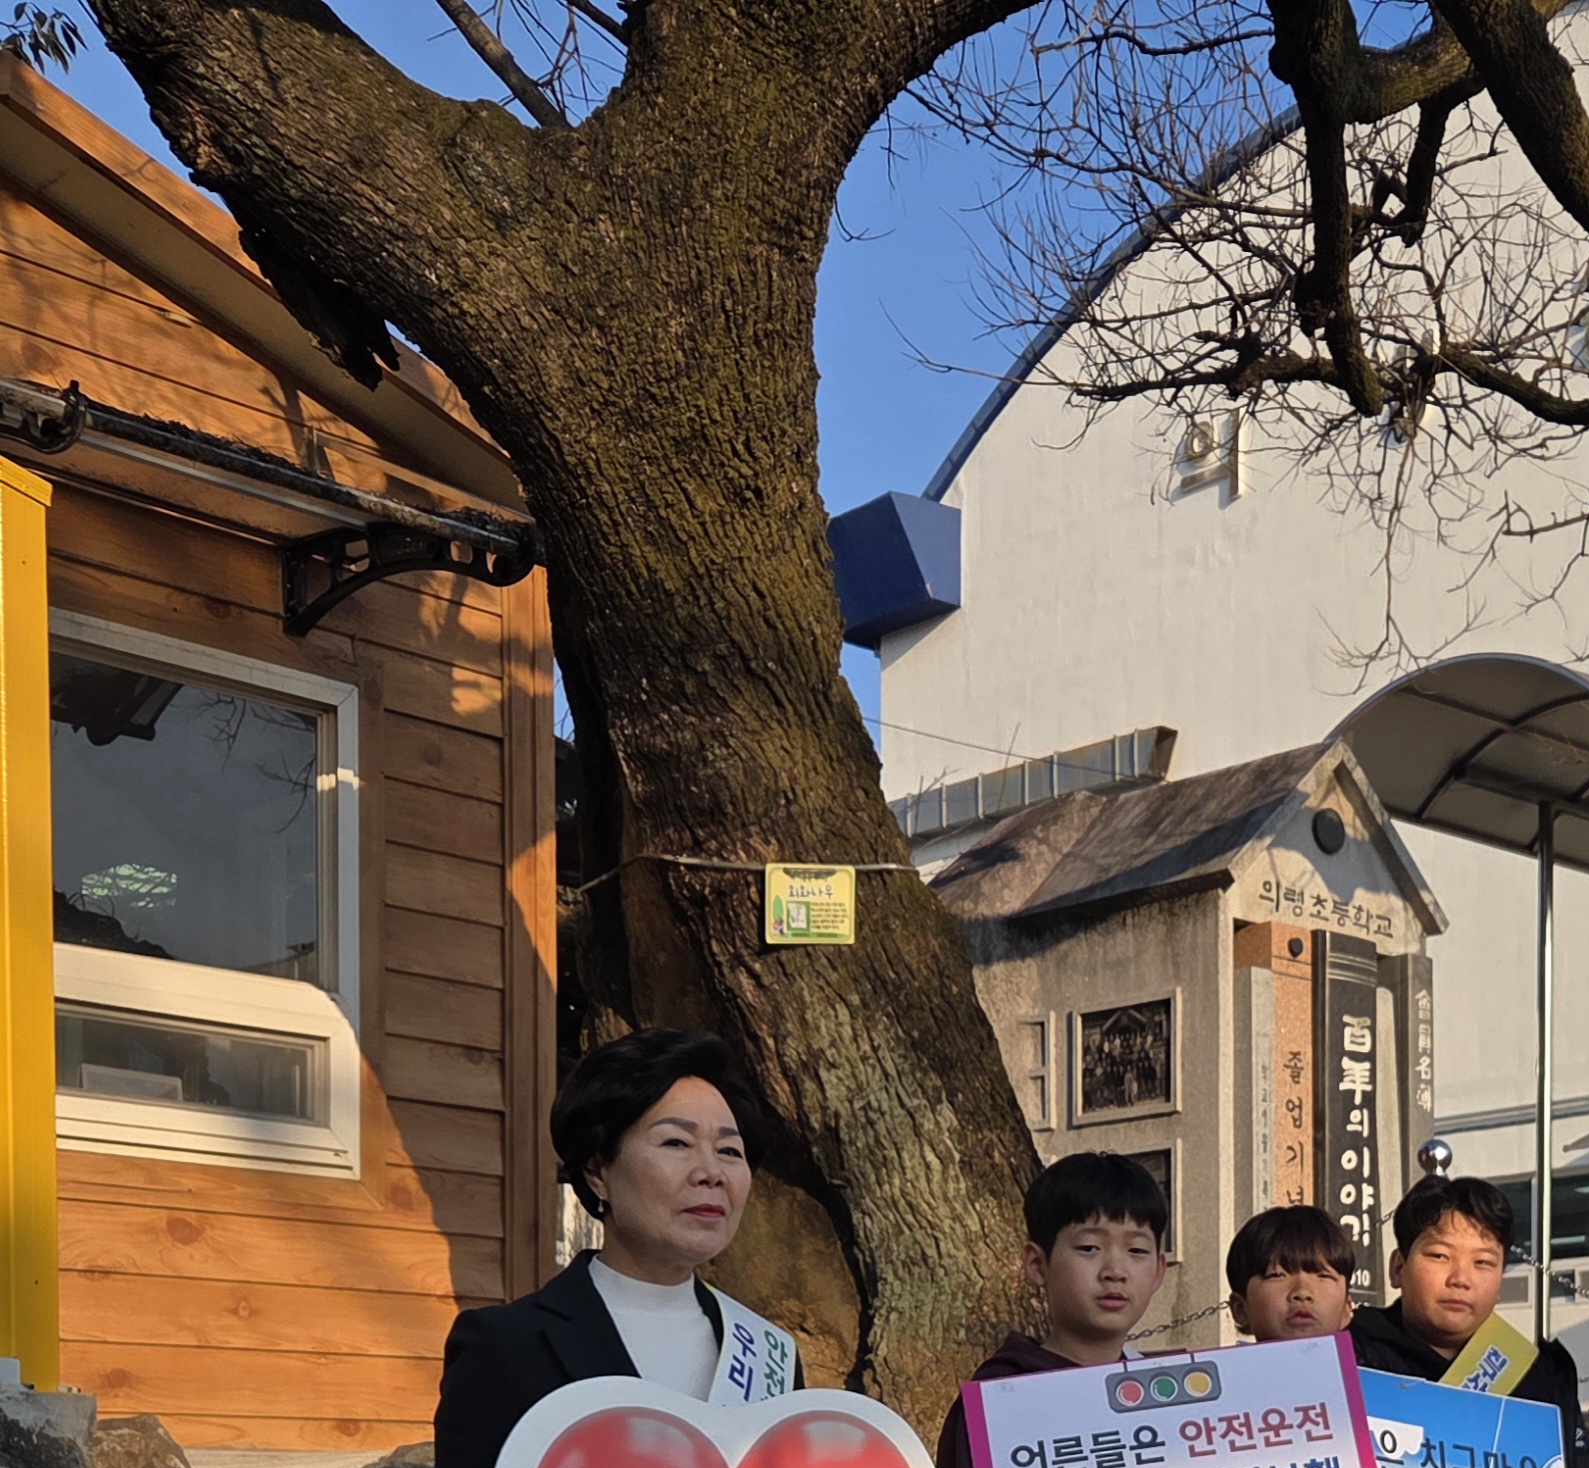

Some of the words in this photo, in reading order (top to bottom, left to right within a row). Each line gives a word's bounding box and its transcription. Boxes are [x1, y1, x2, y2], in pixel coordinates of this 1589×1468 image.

[1258, 880, 1394, 939] 의령초등학교
[1340, 1146, 1376, 1247] 이야기
[1178, 1401, 1334, 1459] 안전운전
